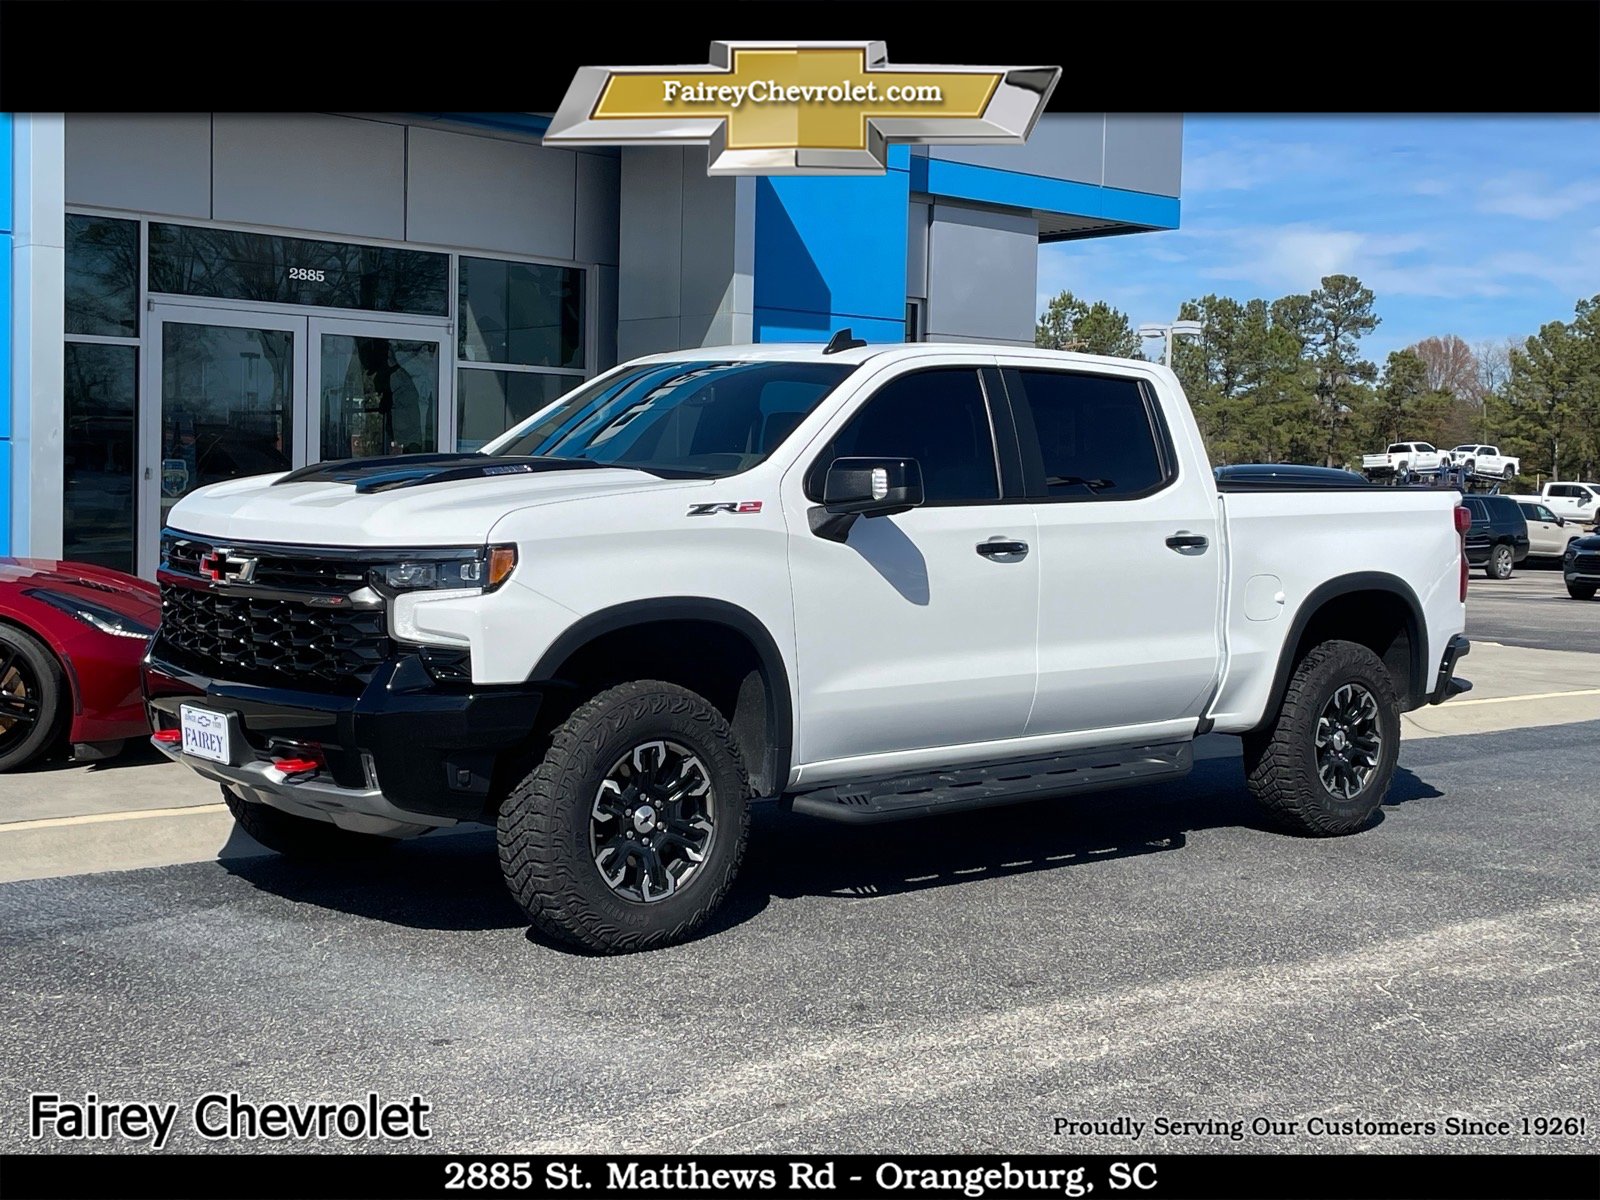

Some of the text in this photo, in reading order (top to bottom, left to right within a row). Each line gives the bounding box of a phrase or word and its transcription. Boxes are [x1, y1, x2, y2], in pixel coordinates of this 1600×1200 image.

[288, 267, 325, 282] 2885
[686, 501, 763, 517] ZR2
[184, 727, 223, 753] FAIREY
